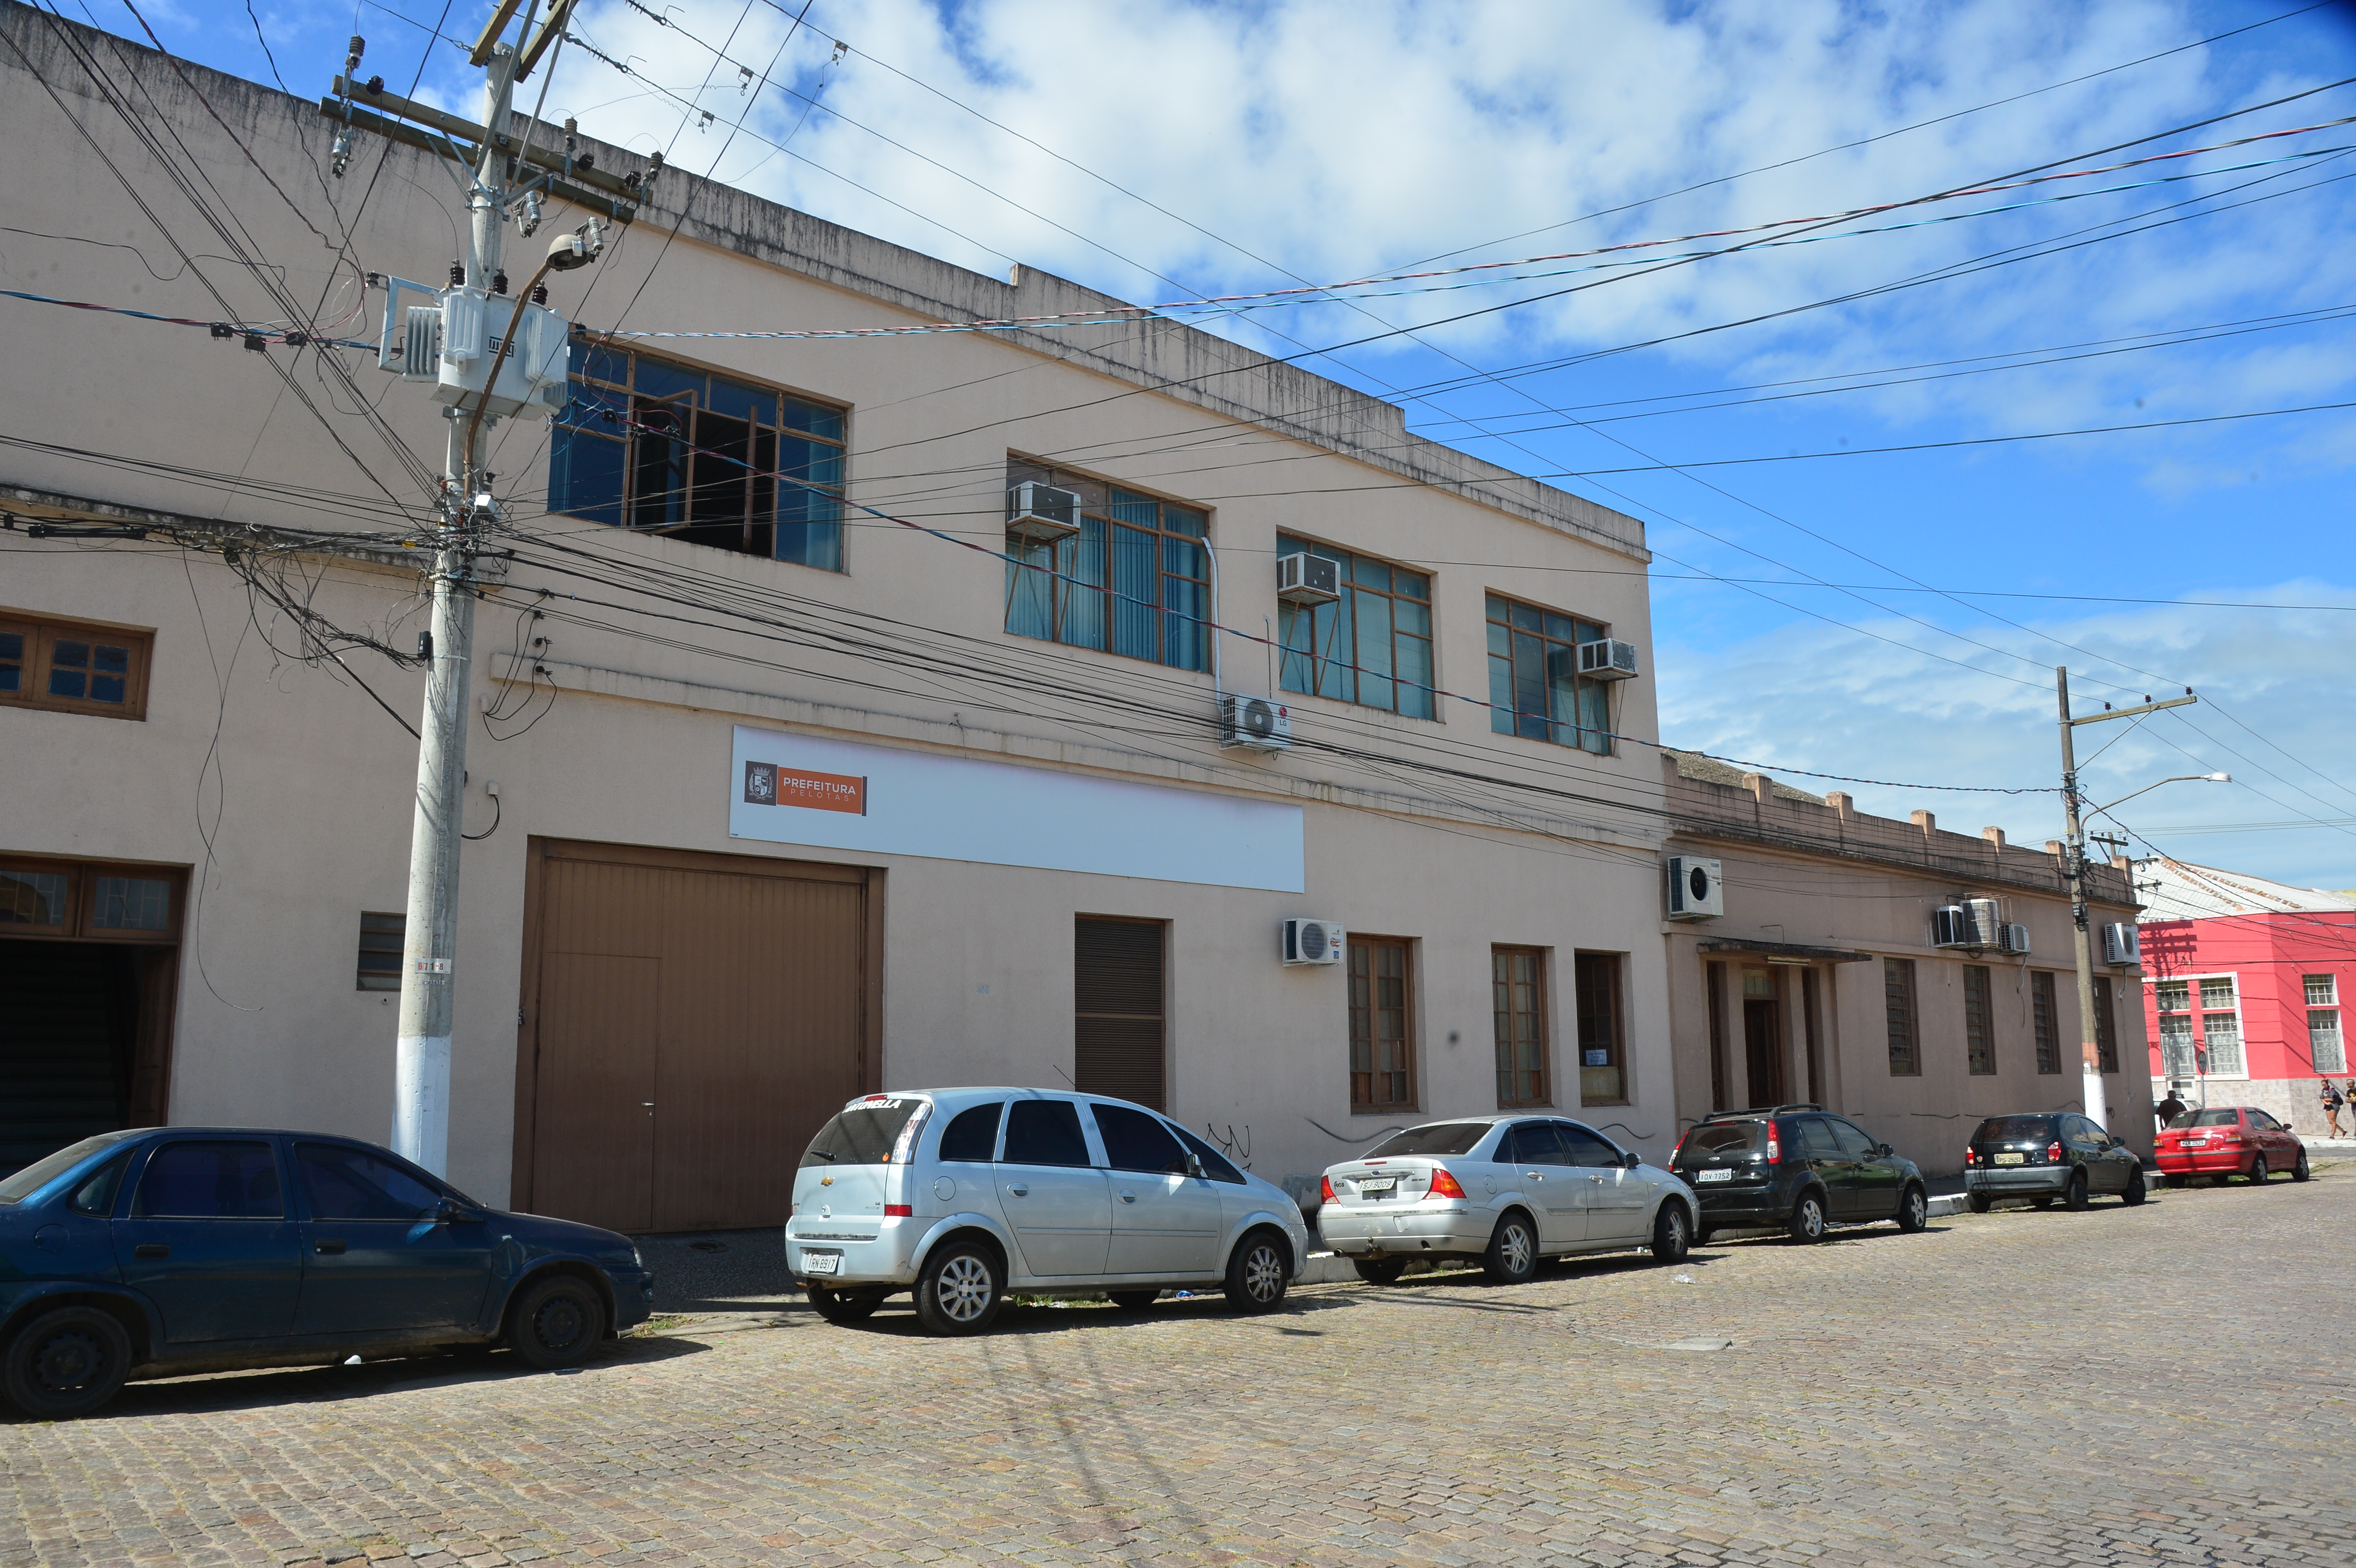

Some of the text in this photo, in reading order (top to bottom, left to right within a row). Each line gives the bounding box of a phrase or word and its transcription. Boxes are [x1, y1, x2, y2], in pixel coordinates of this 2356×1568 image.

[784, 777, 856, 795] PREFEITURA
[791, 789, 849, 802] PELOTAS
[418, 962, 444, 970] 671-8
[841, 1100, 902, 1114] ANTONELLA
